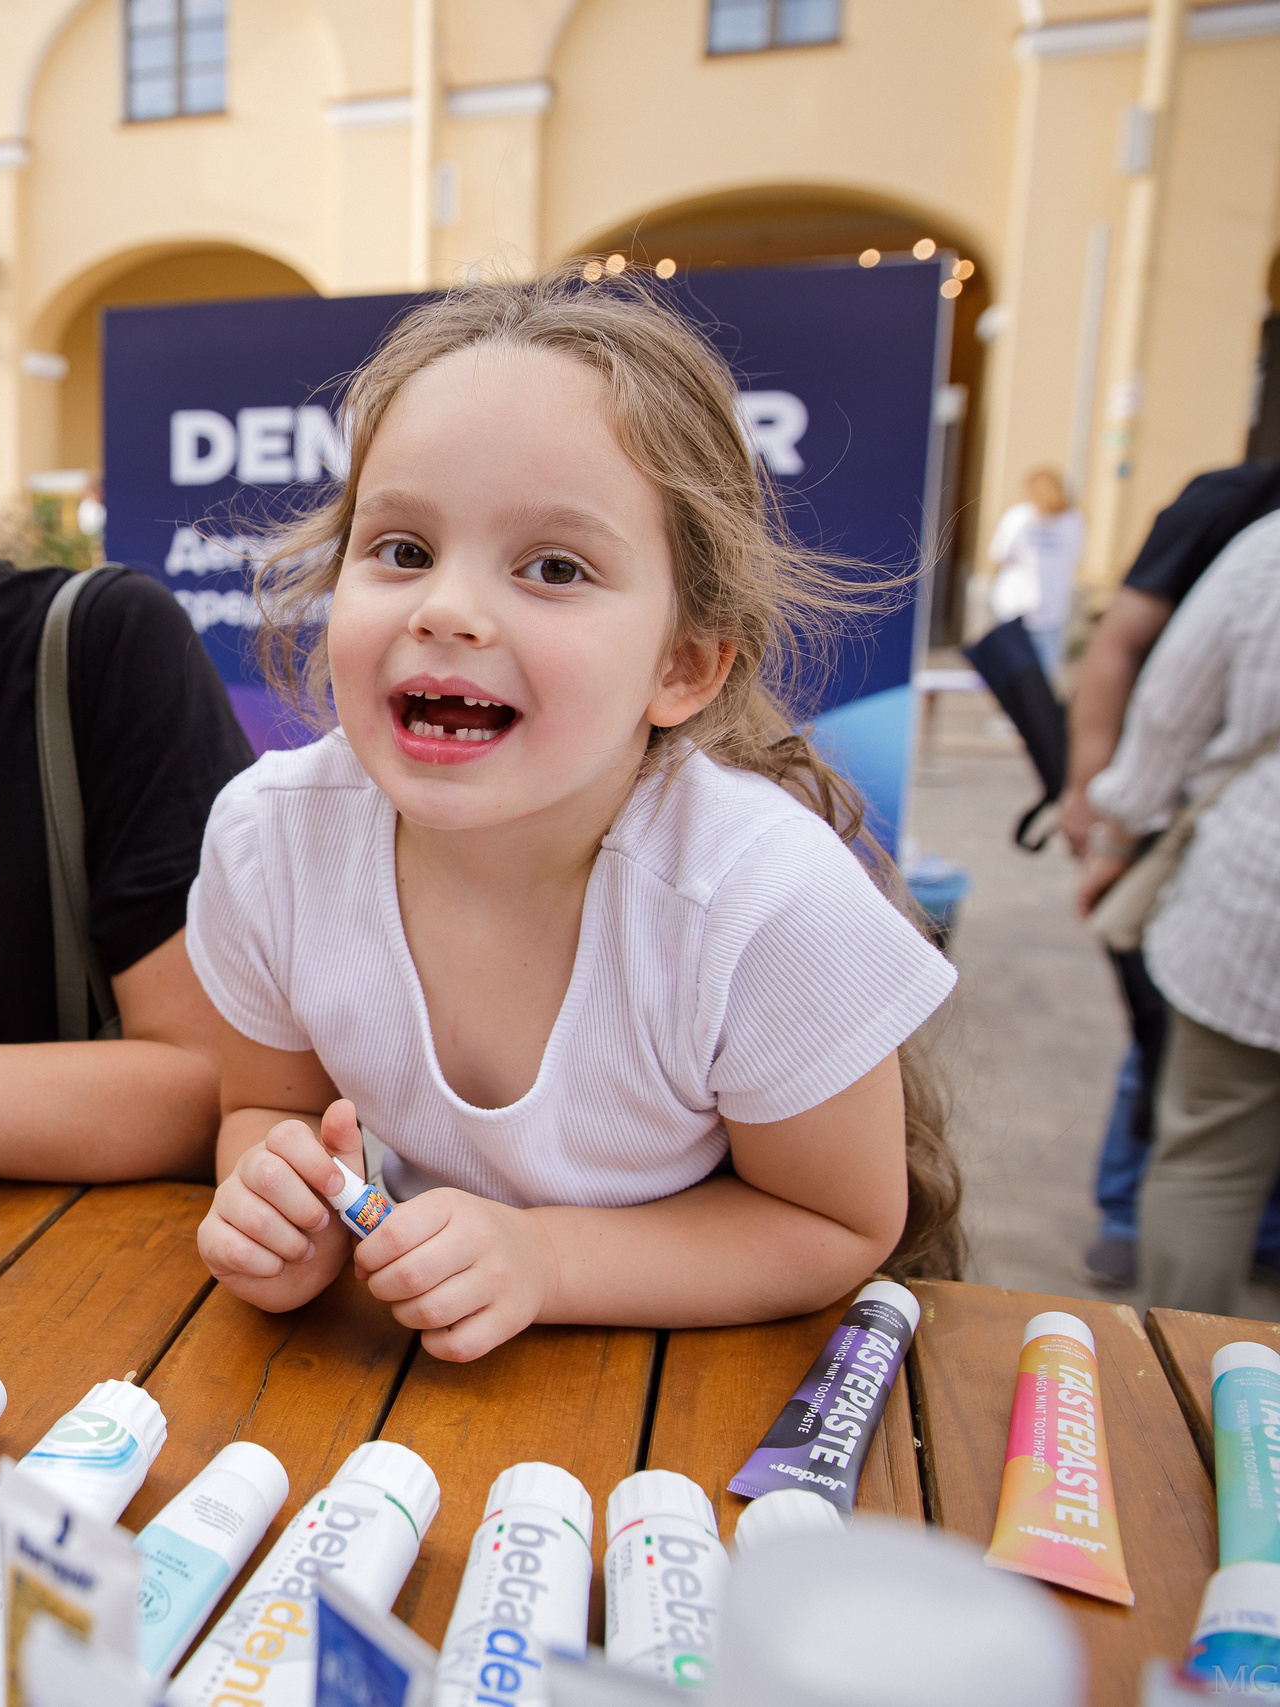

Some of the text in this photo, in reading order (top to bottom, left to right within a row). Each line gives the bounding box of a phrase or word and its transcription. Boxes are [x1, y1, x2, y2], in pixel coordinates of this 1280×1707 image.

[170, 389, 809, 486] DEN R
[355, 1190, 380, 1227] MANIA
[859, 1307, 904, 1329] with fluoride
[863, 1311, 899, 1328] whitening
[873, 1304, 898, 1317] VEGAN
[1051, 1338, 1079, 1348] VEGAN
[798, 1325, 861, 1434] LIQUORICE MINT TOOTHPASTE
[809, 1327, 900, 1469] TASTEPASTE
[1032, 1364, 1048, 1474] MANGO MINT TOOTHPASTE
[1055, 1364, 1099, 1529] TASTEPASTE
[1235, 1399, 1264, 1510] FRESH MINT TOOTHPASTE
